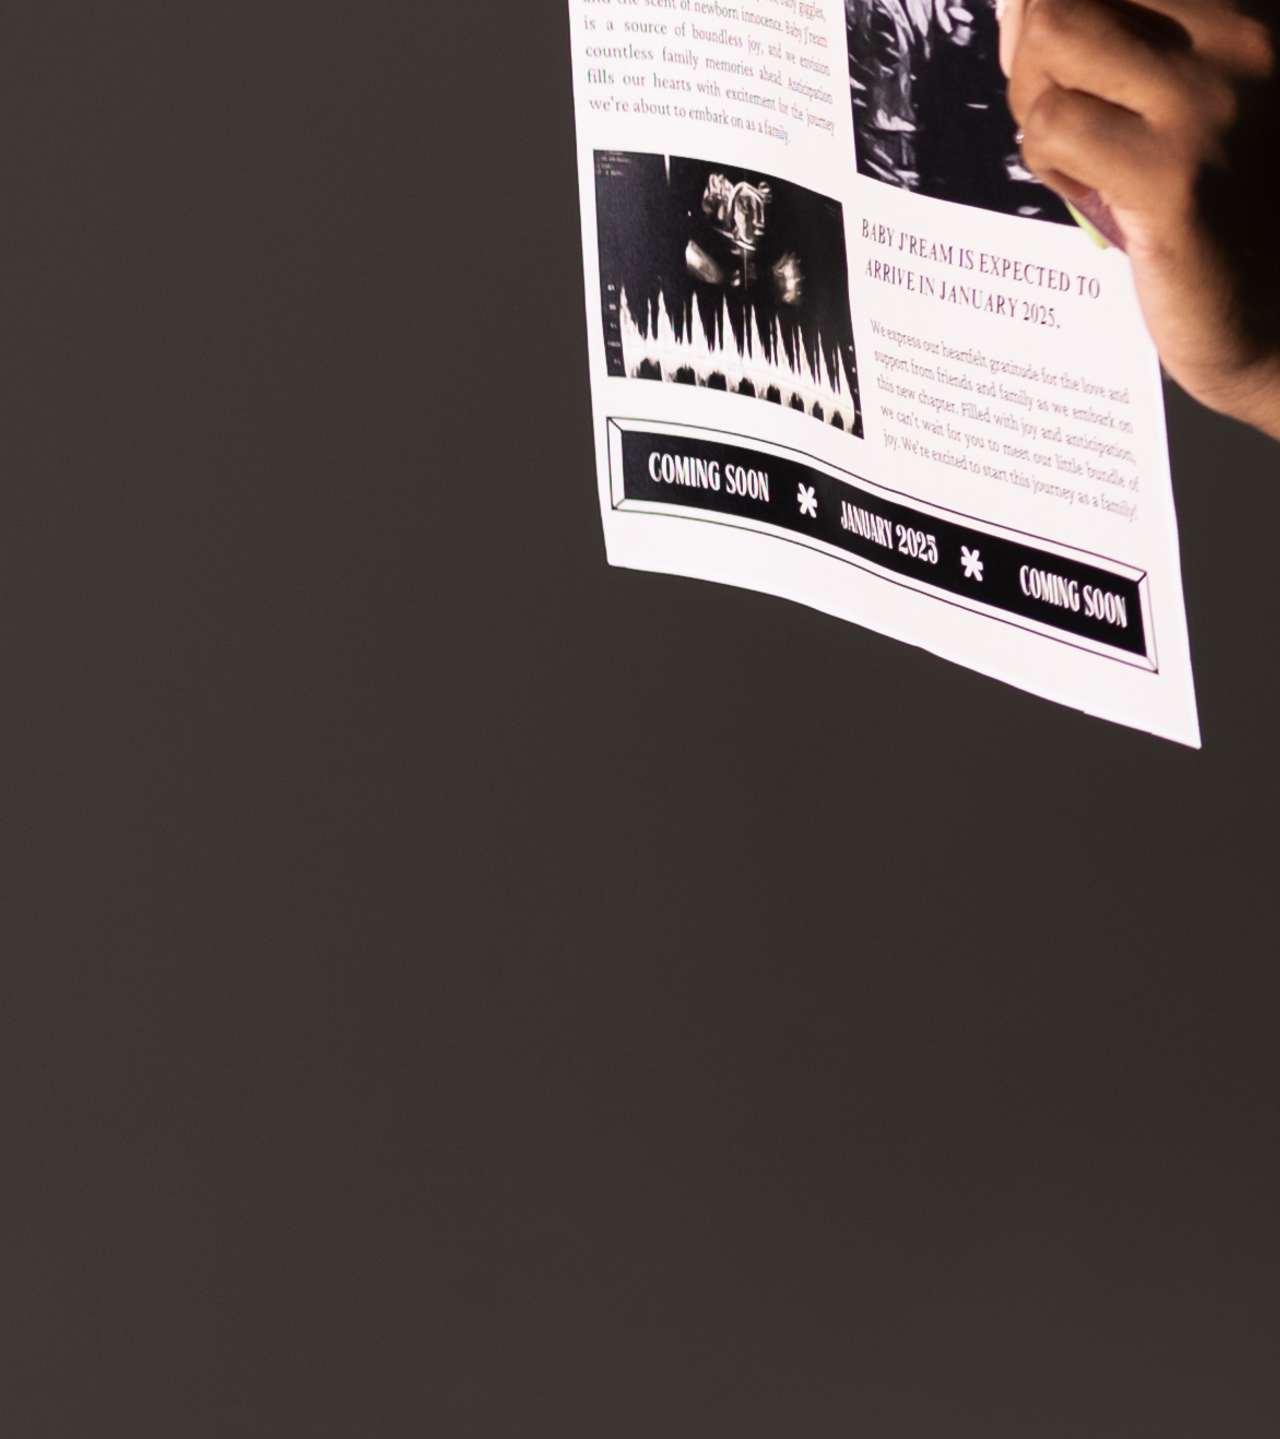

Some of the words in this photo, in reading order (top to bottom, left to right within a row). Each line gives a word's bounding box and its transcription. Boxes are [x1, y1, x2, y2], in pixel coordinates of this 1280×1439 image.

[583, 15, 596, 31] is
[606, 20, 614, 31] a
[624, 21, 667, 35] source
[674, 21, 685, 37] of
[692, 23, 743, 48] boundless
[694, 0, 739, 20] newborn
[585, 43, 654, 61] countless
[662, 46, 699, 70] family
[705, 58, 754, 77] memories
[587, 68, 615, 85] fills
[623, 74, 645, 86] our
[653, 72, 692, 92] hearts
[697, 79, 720, 97] with
[589, 96, 629, 112] we're
[633, 97, 672, 117] about
[674, 105, 686, 118] to
[689, 106, 729, 125] embark
[730, 115, 743, 129] on
[746, 120, 756, 132] as
[861, 218, 896, 248] BABY
[898, 231, 954, 267] J'REAM
[958, 247, 975, 272] IS
[979, 253, 1071, 294] EXPECTED
[1075, 274, 1101, 300] TO
[864, 258, 916, 293] ARRIVE
[919, 273, 936, 297] IN
[938, 281, 1019, 320] JANUARY
[1022, 301, 1061, 329] 2025.
[870, 319, 886, 337] We
[887, 328, 921, 348] express
[1060, 372, 1080, 391] the
[874, 350, 909, 372] support
[936, 366, 973, 392] friends
[976, 381, 996, 398] and
[1051, 401, 1069, 417] we
[877, 374, 894, 394] this
[896, 384, 915, 400] new
[961, 402, 991, 423] Filled
[993, 412, 1019, 432] with
[880, 405, 894, 420] we
[964, 433, 985, 449] you
[988, 439, 999, 453] to
[648, 451, 721, 493] COMING
[724, 462, 770, 504] SOON
[969, 459, 981, 474] to
[840, 500, 894, 550] JANUARY
[896, 524, 939, 565] 2025
[1019, 564, 1080, 613] COMING
[1083, 584, 1128, 629] SOON
